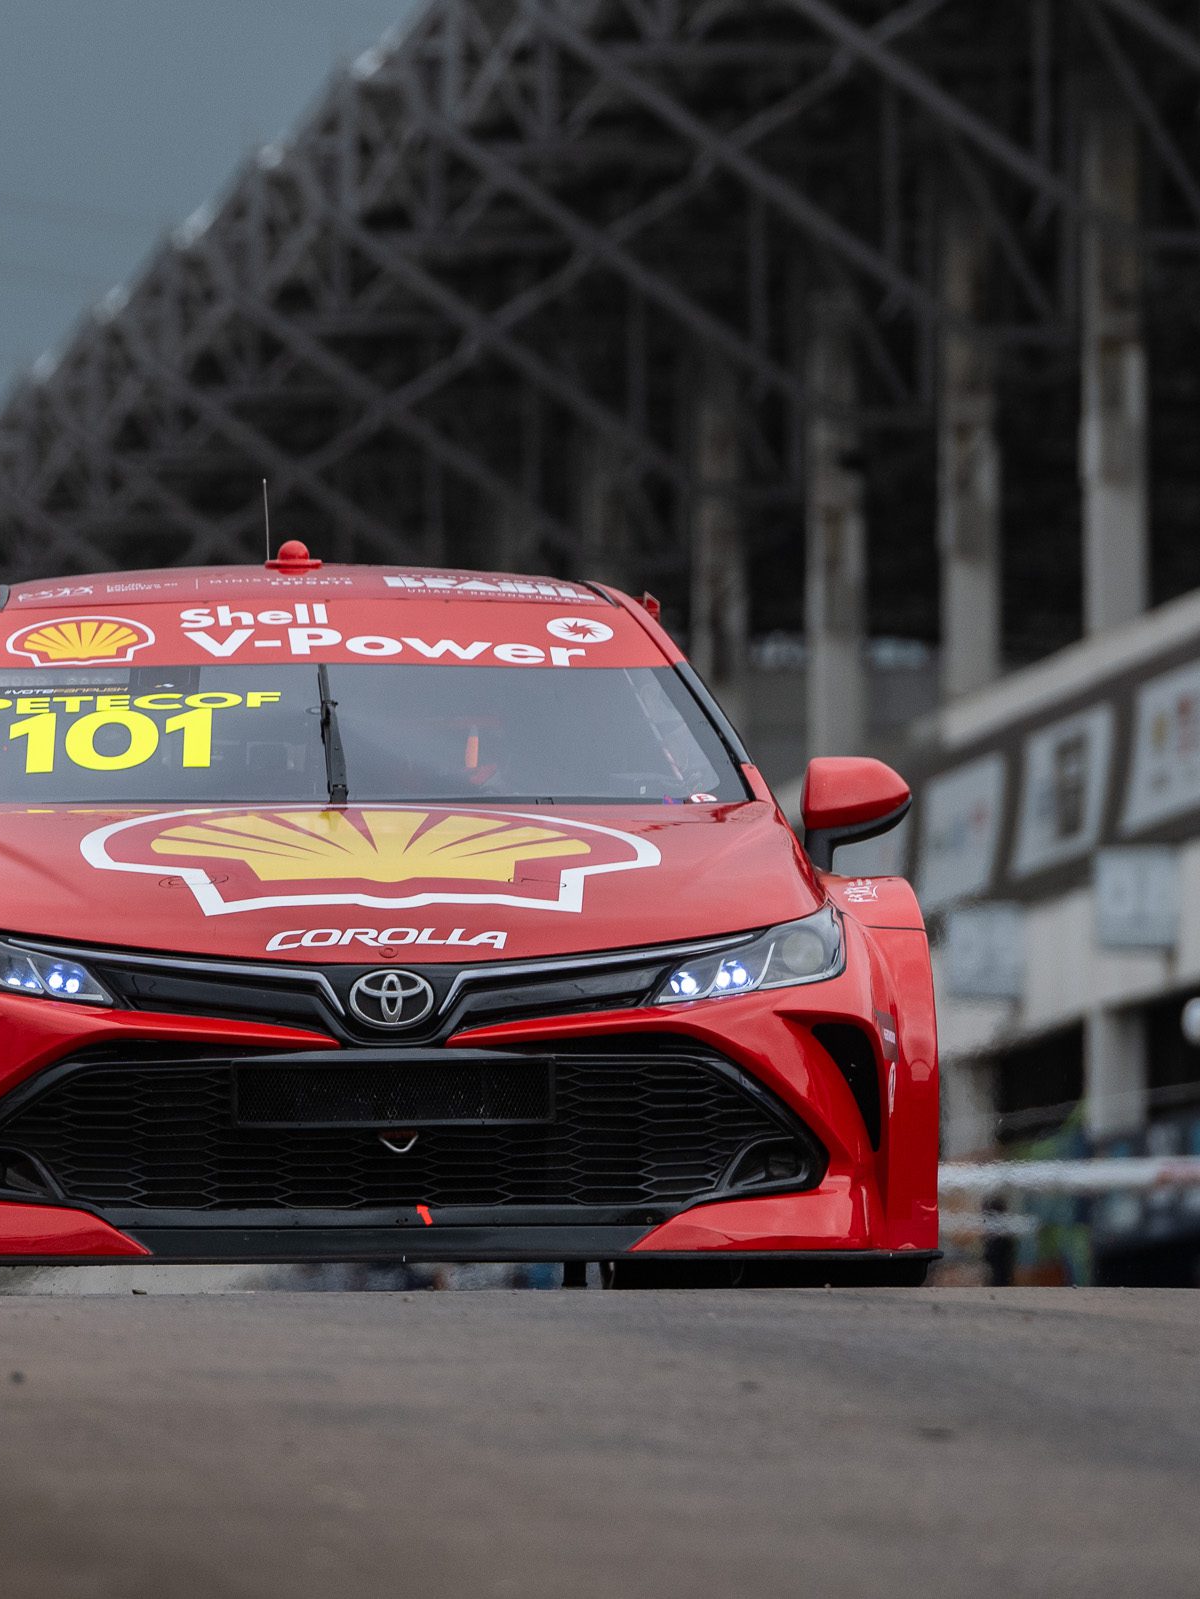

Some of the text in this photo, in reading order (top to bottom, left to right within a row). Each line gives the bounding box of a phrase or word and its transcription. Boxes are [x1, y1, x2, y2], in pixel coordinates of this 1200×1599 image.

[180, 603, 328, 628] Shell
[183, 628, 586, 667] V-Power
[9, 708, 213, 773] 101
[266, 928, 507, 951] COROLLA
